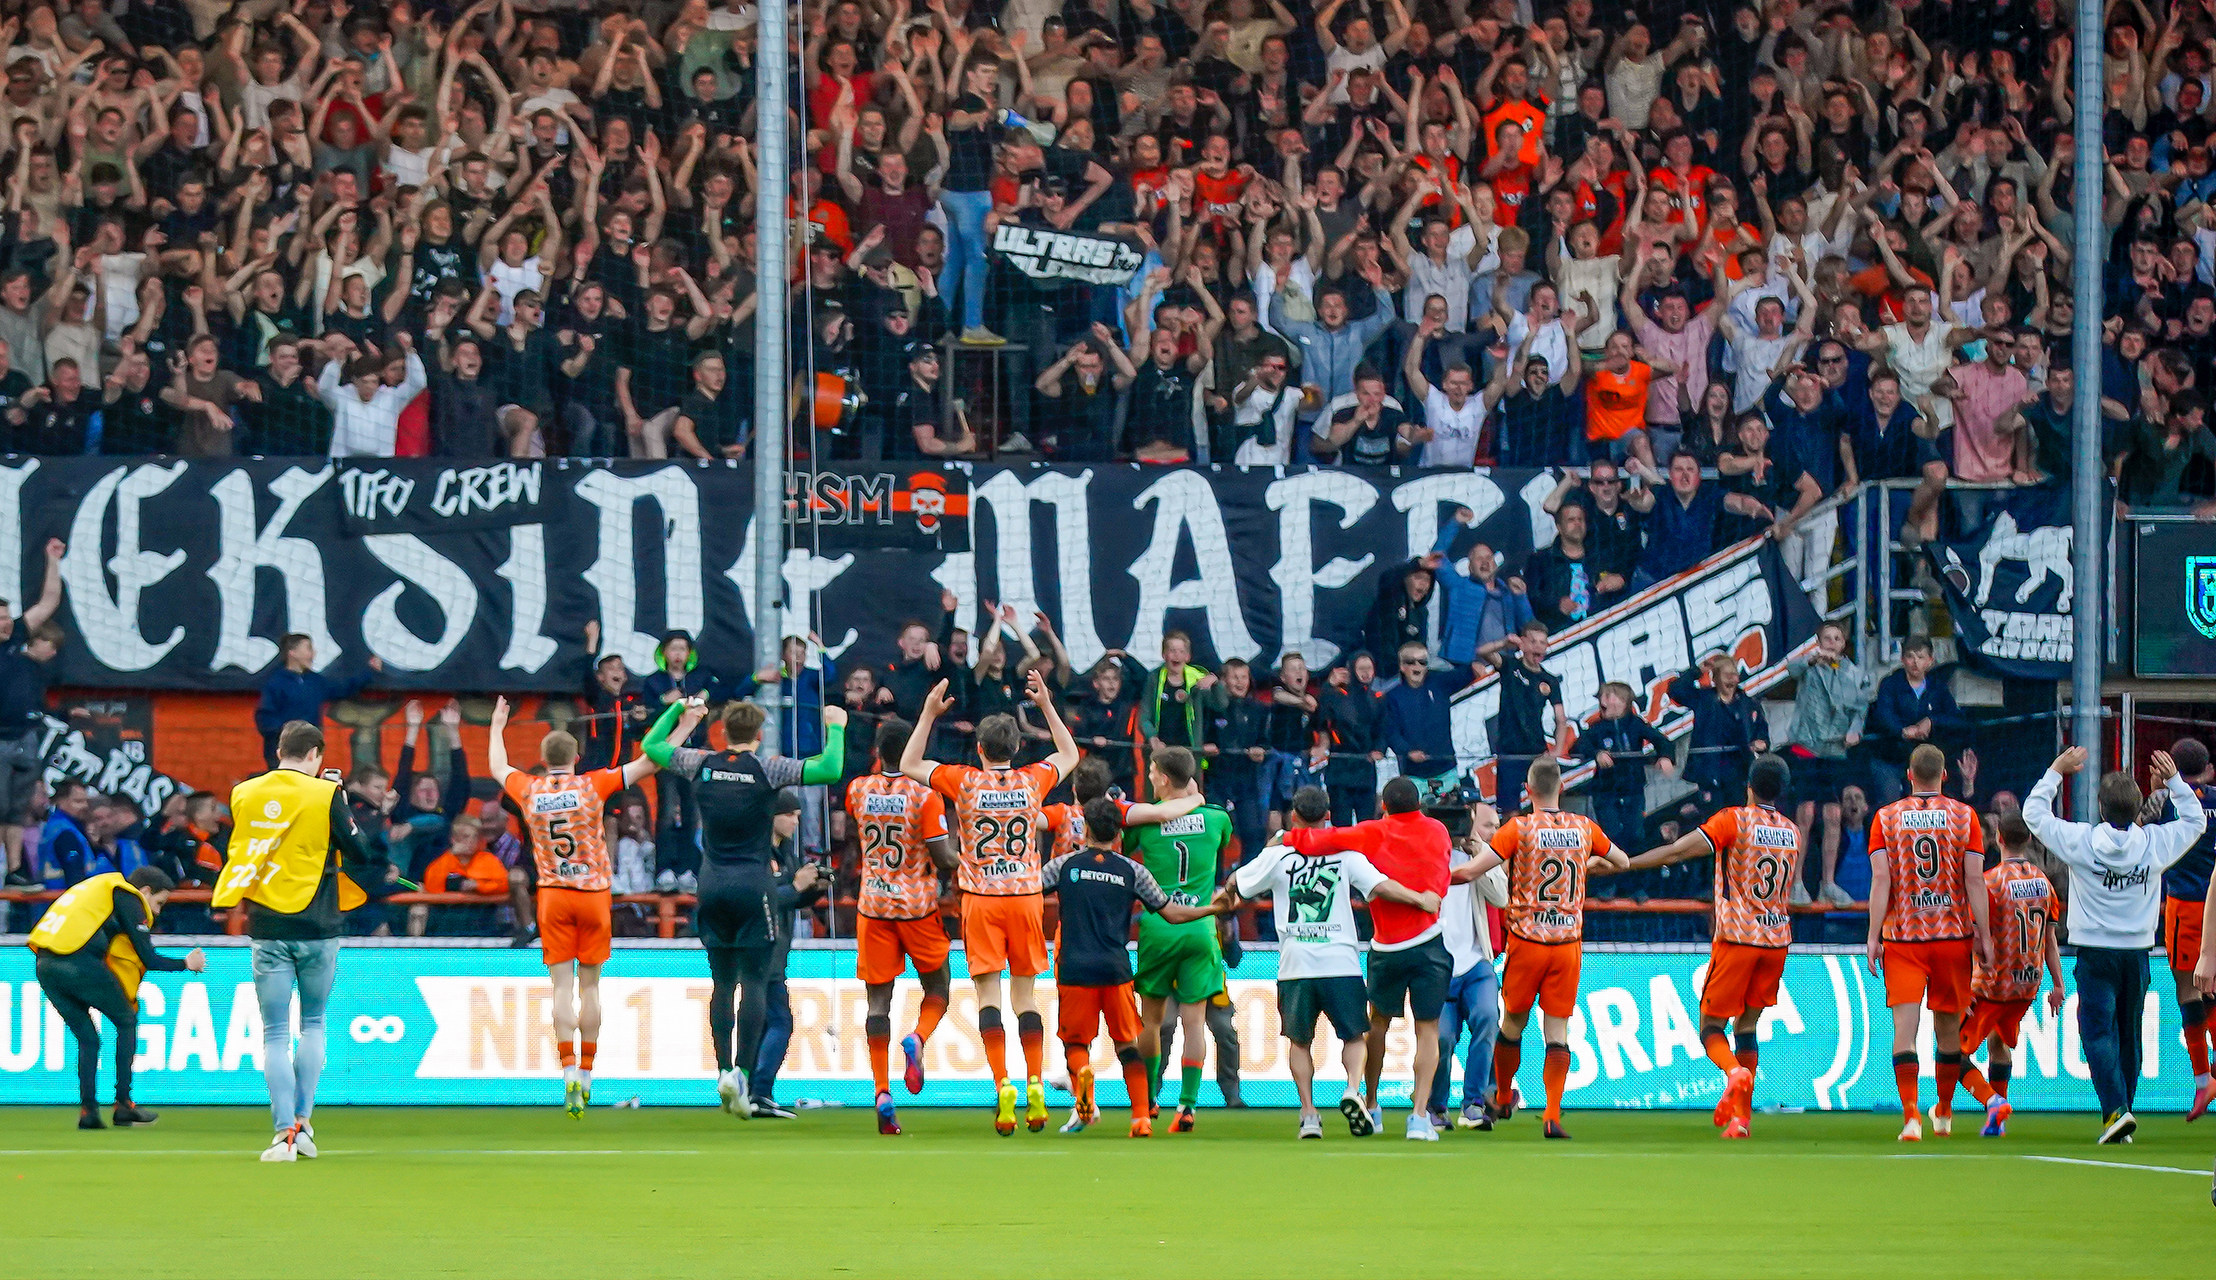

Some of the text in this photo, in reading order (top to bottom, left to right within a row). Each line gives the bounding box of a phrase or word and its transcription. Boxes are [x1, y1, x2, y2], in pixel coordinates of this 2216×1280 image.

[993, 224, 1117, 267] ULTRAS
[338, 462, 542, 520] TIFO CREW
[781, 471, 895, 525] HSM
[548, 818, 576, 859] 5
[863, 822, 906, 870] 25
[974, 814, 1028, 859] 28
[1914, 834, 1939, 880] 9
[1174, 841, 1189, 885] 1
[1538, 857, 1577, 904] 21
[1752, 855, 1790, 901] 31
[2015, 906, 2046, 955] 17
[625, 986, 653, 1071] 1
